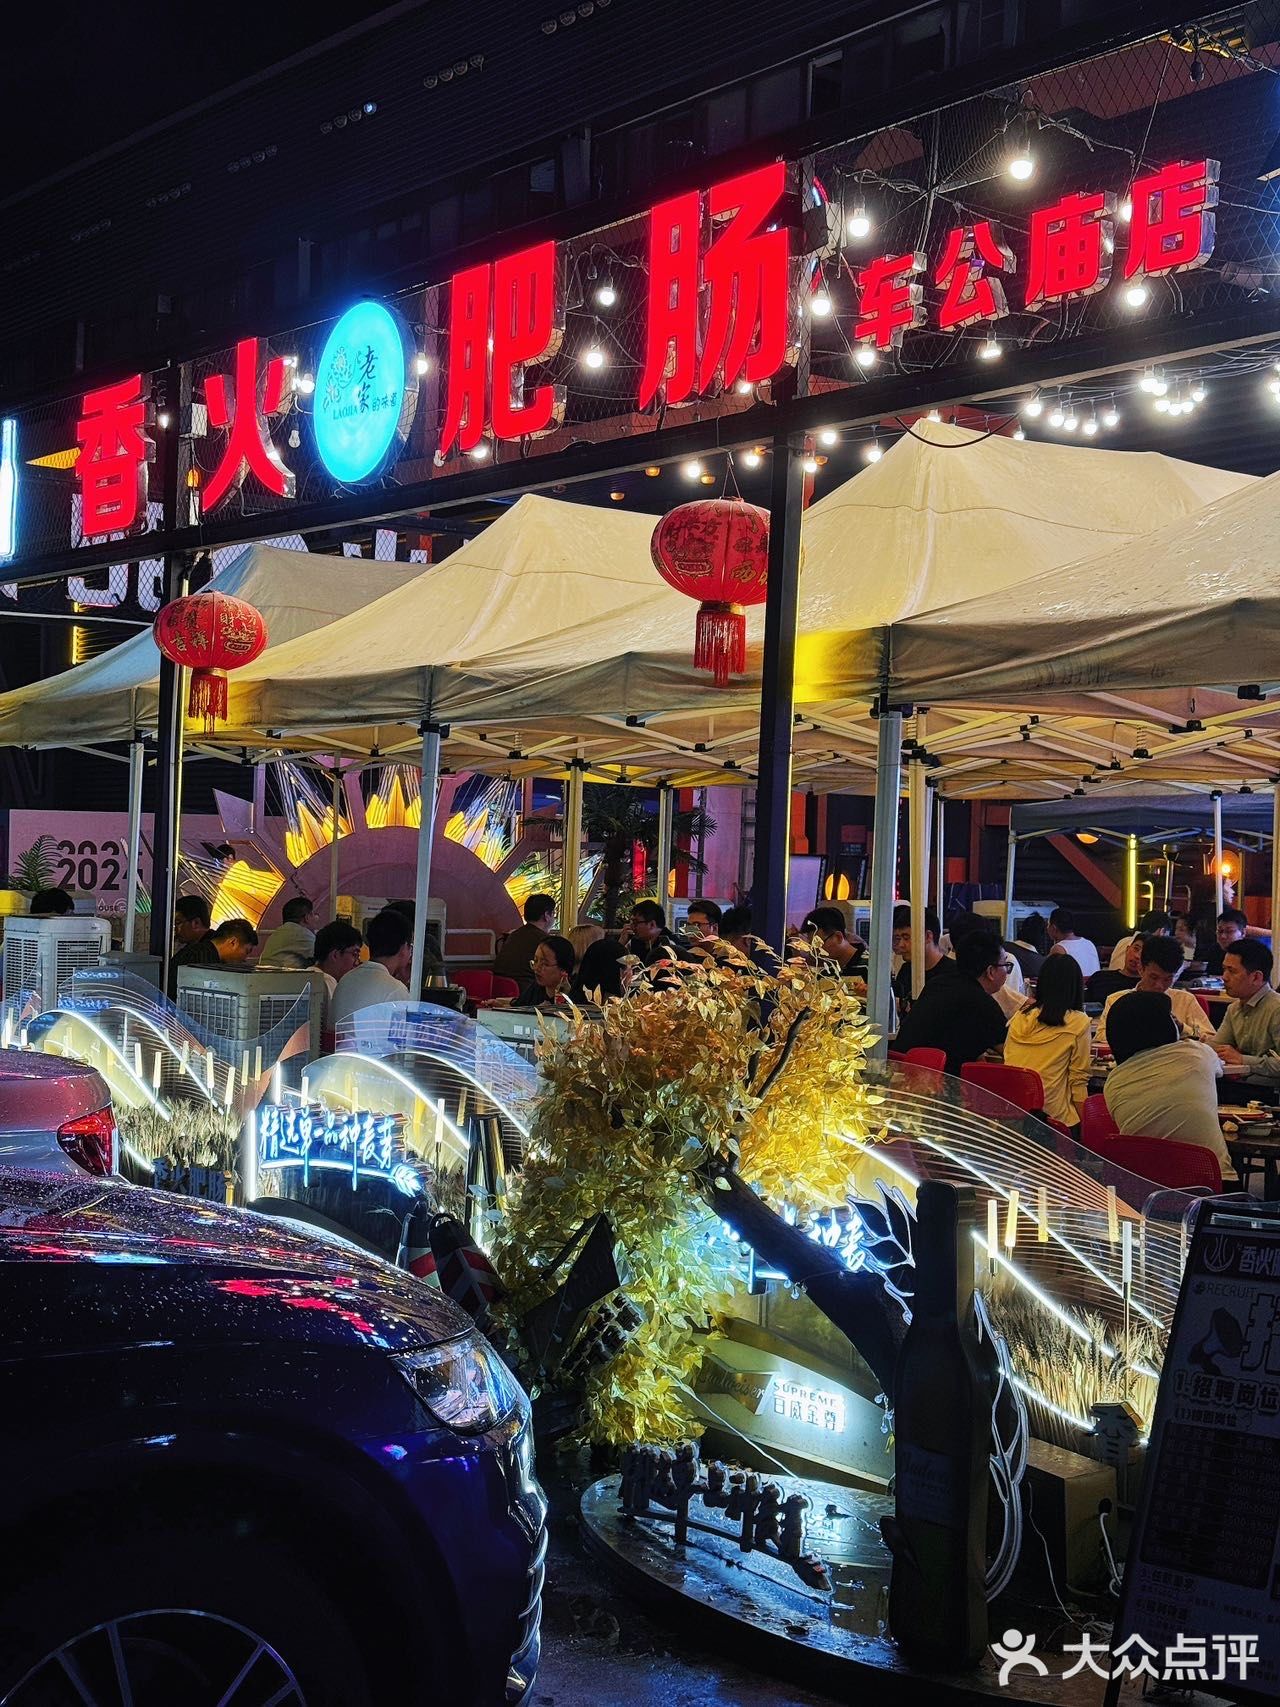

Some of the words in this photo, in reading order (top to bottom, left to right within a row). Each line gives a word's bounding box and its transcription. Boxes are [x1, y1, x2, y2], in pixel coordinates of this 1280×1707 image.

[855, 159, 1207, 348] 车公庙店
[773, 1381, 837, 1407] SUPREME
